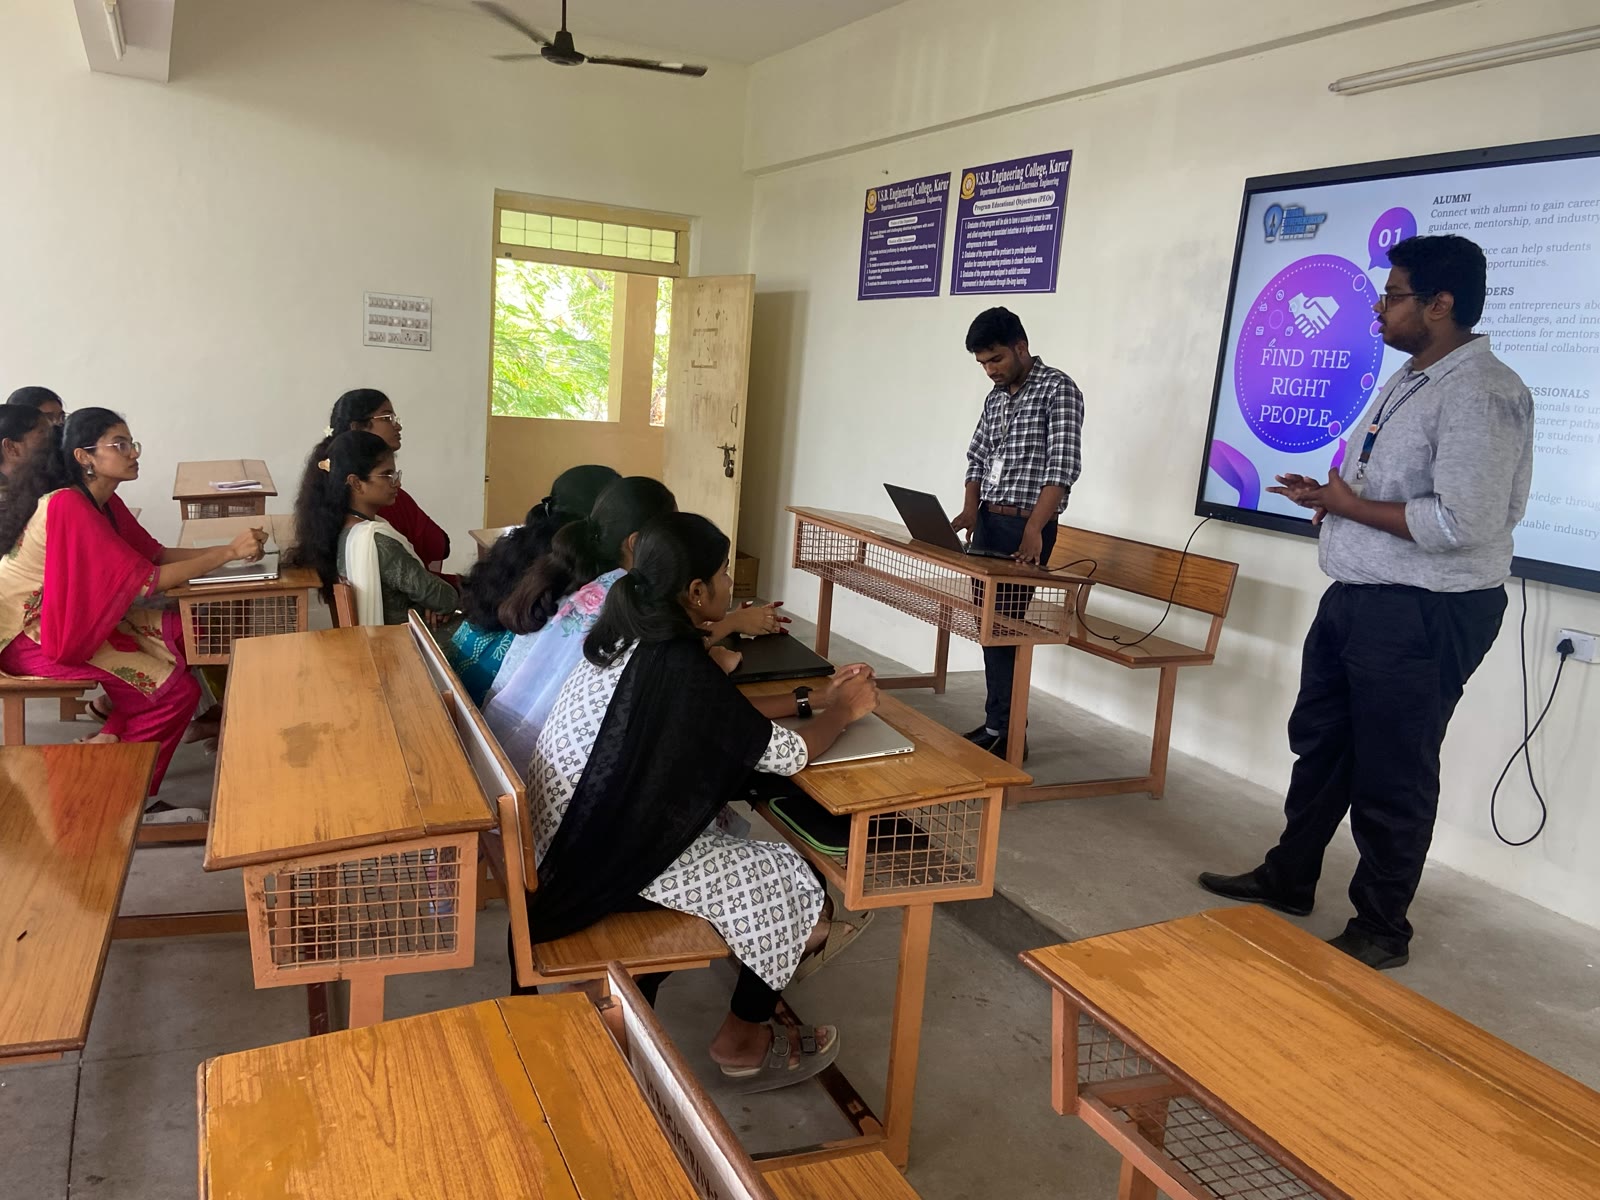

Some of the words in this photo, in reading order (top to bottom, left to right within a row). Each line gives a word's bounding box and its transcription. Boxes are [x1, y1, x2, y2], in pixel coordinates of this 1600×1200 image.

[976, 172, 990, 186] V.S.B.
[992, 166, 1024, 186] Engineering
[1025, 163, 1048, 180] College,
[1049, 159, 1069, 174] Karur
[1040, 178, 1059, 188] Engineering
[890, 184, 914, 202] Engineering
[915, 182, 933, 196] College,
[934, 179, 949, 192] Karur
[974, 202, 991, 212] Program
[992, 200, 1015, 209] Educational
[1016, 196, 1037, 208] Objectives
[1433, 193, 1471, 205] ALUMNI
[1431, 208, 1467, 218] Connect
[1470, 205, 1490, 215] with
[1493, 202, 1527, 214] alumni
[1531, 203, 1540, 211] to
[1542, 201, 1564, 212] gain
[1568, 199, 1600, 208] career
[1428, 221, 1471, 234] guidance,
[1474, 216, 1531, 228] mentorship,
[1535, 214, 1554, 224] and
[1557, 212, 1600, 224] industry
[1378, 228, 1402, 248] 01
[1501, 246, 1518, 254] can
[1521, 243, 1543, 255] help
[1546, 242, 1592, 252] students
[1487, 258, 1549, 270] pportunities.
[1486, 287, 1514, 296] DERS
[1509, 302, 1581, 311] entrepreneurs
[1584, 300, 1600, 310] abo
[1498, 314, 1552, 326] challenges,
[1556, 314, 1576, 324] and
[1540, 328, 1553, 338] for
[1556, 330, 1600, 338] mentors
[1490, 342, 1501, 350] nd
[1504, 342, 1548, 353] potential
[1551, 342, 1600, 353] collabora
[1260, 348, 1304, 367] FIND
[1310, 349, 1351, 370] THE
[1270, 377, 1330, 398] RIGHT
[1535, 401, 1570, 412] sionals
[1574, 404, 1584, 413] to
[1258, 405, 1332, 428] PEOPLE
[1535, 417, 1567, 426] career
[1535, 429, 1544, 441] lp
[1547, 432, 1594, 443] students
[1529, 491, 1562, 505] wledge
[1565, 496, 1600, 511] throug
[1554, 523, 1600, 540] industry
